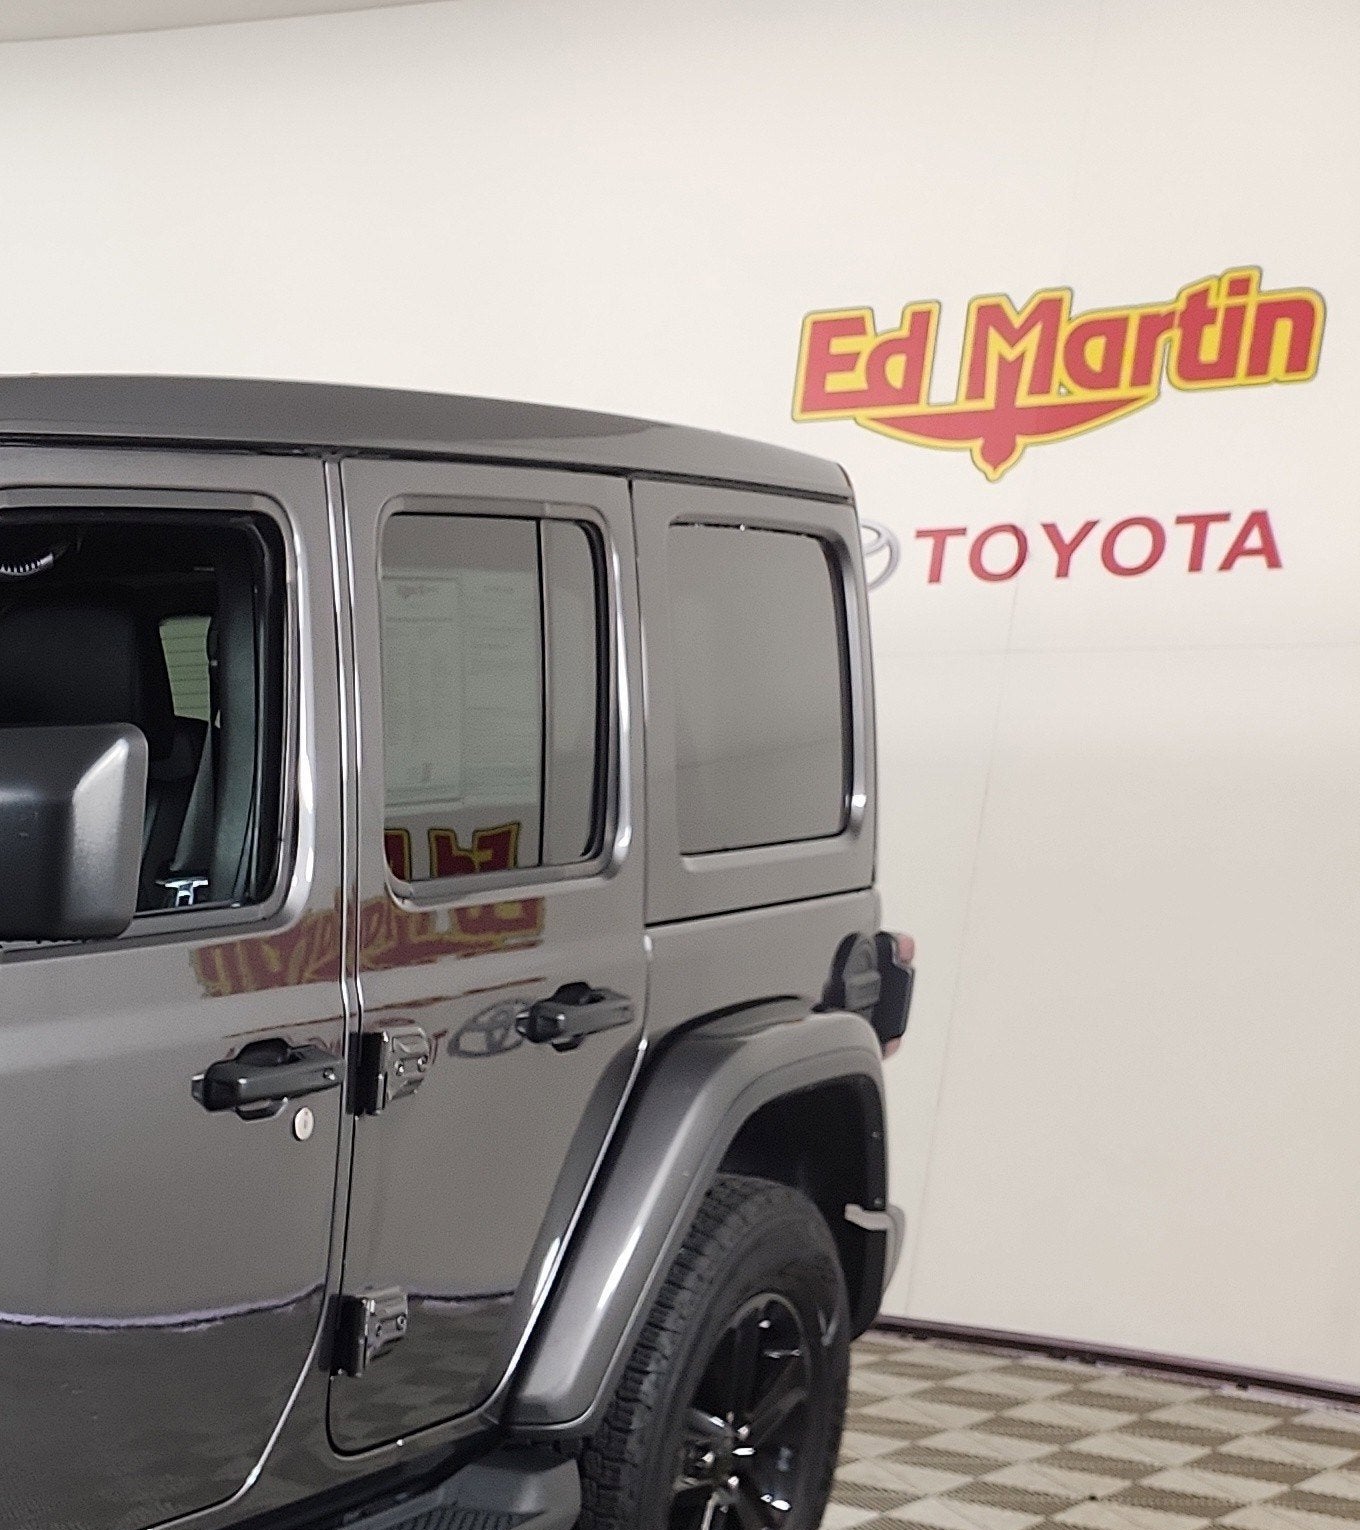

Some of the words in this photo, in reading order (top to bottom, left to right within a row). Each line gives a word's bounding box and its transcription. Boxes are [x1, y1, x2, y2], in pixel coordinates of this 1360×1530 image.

[798, 308, 934, 415] Ed
[961, 273, 1320, 402] Martin
[916, 510, 1282, 583] TOYOTA
